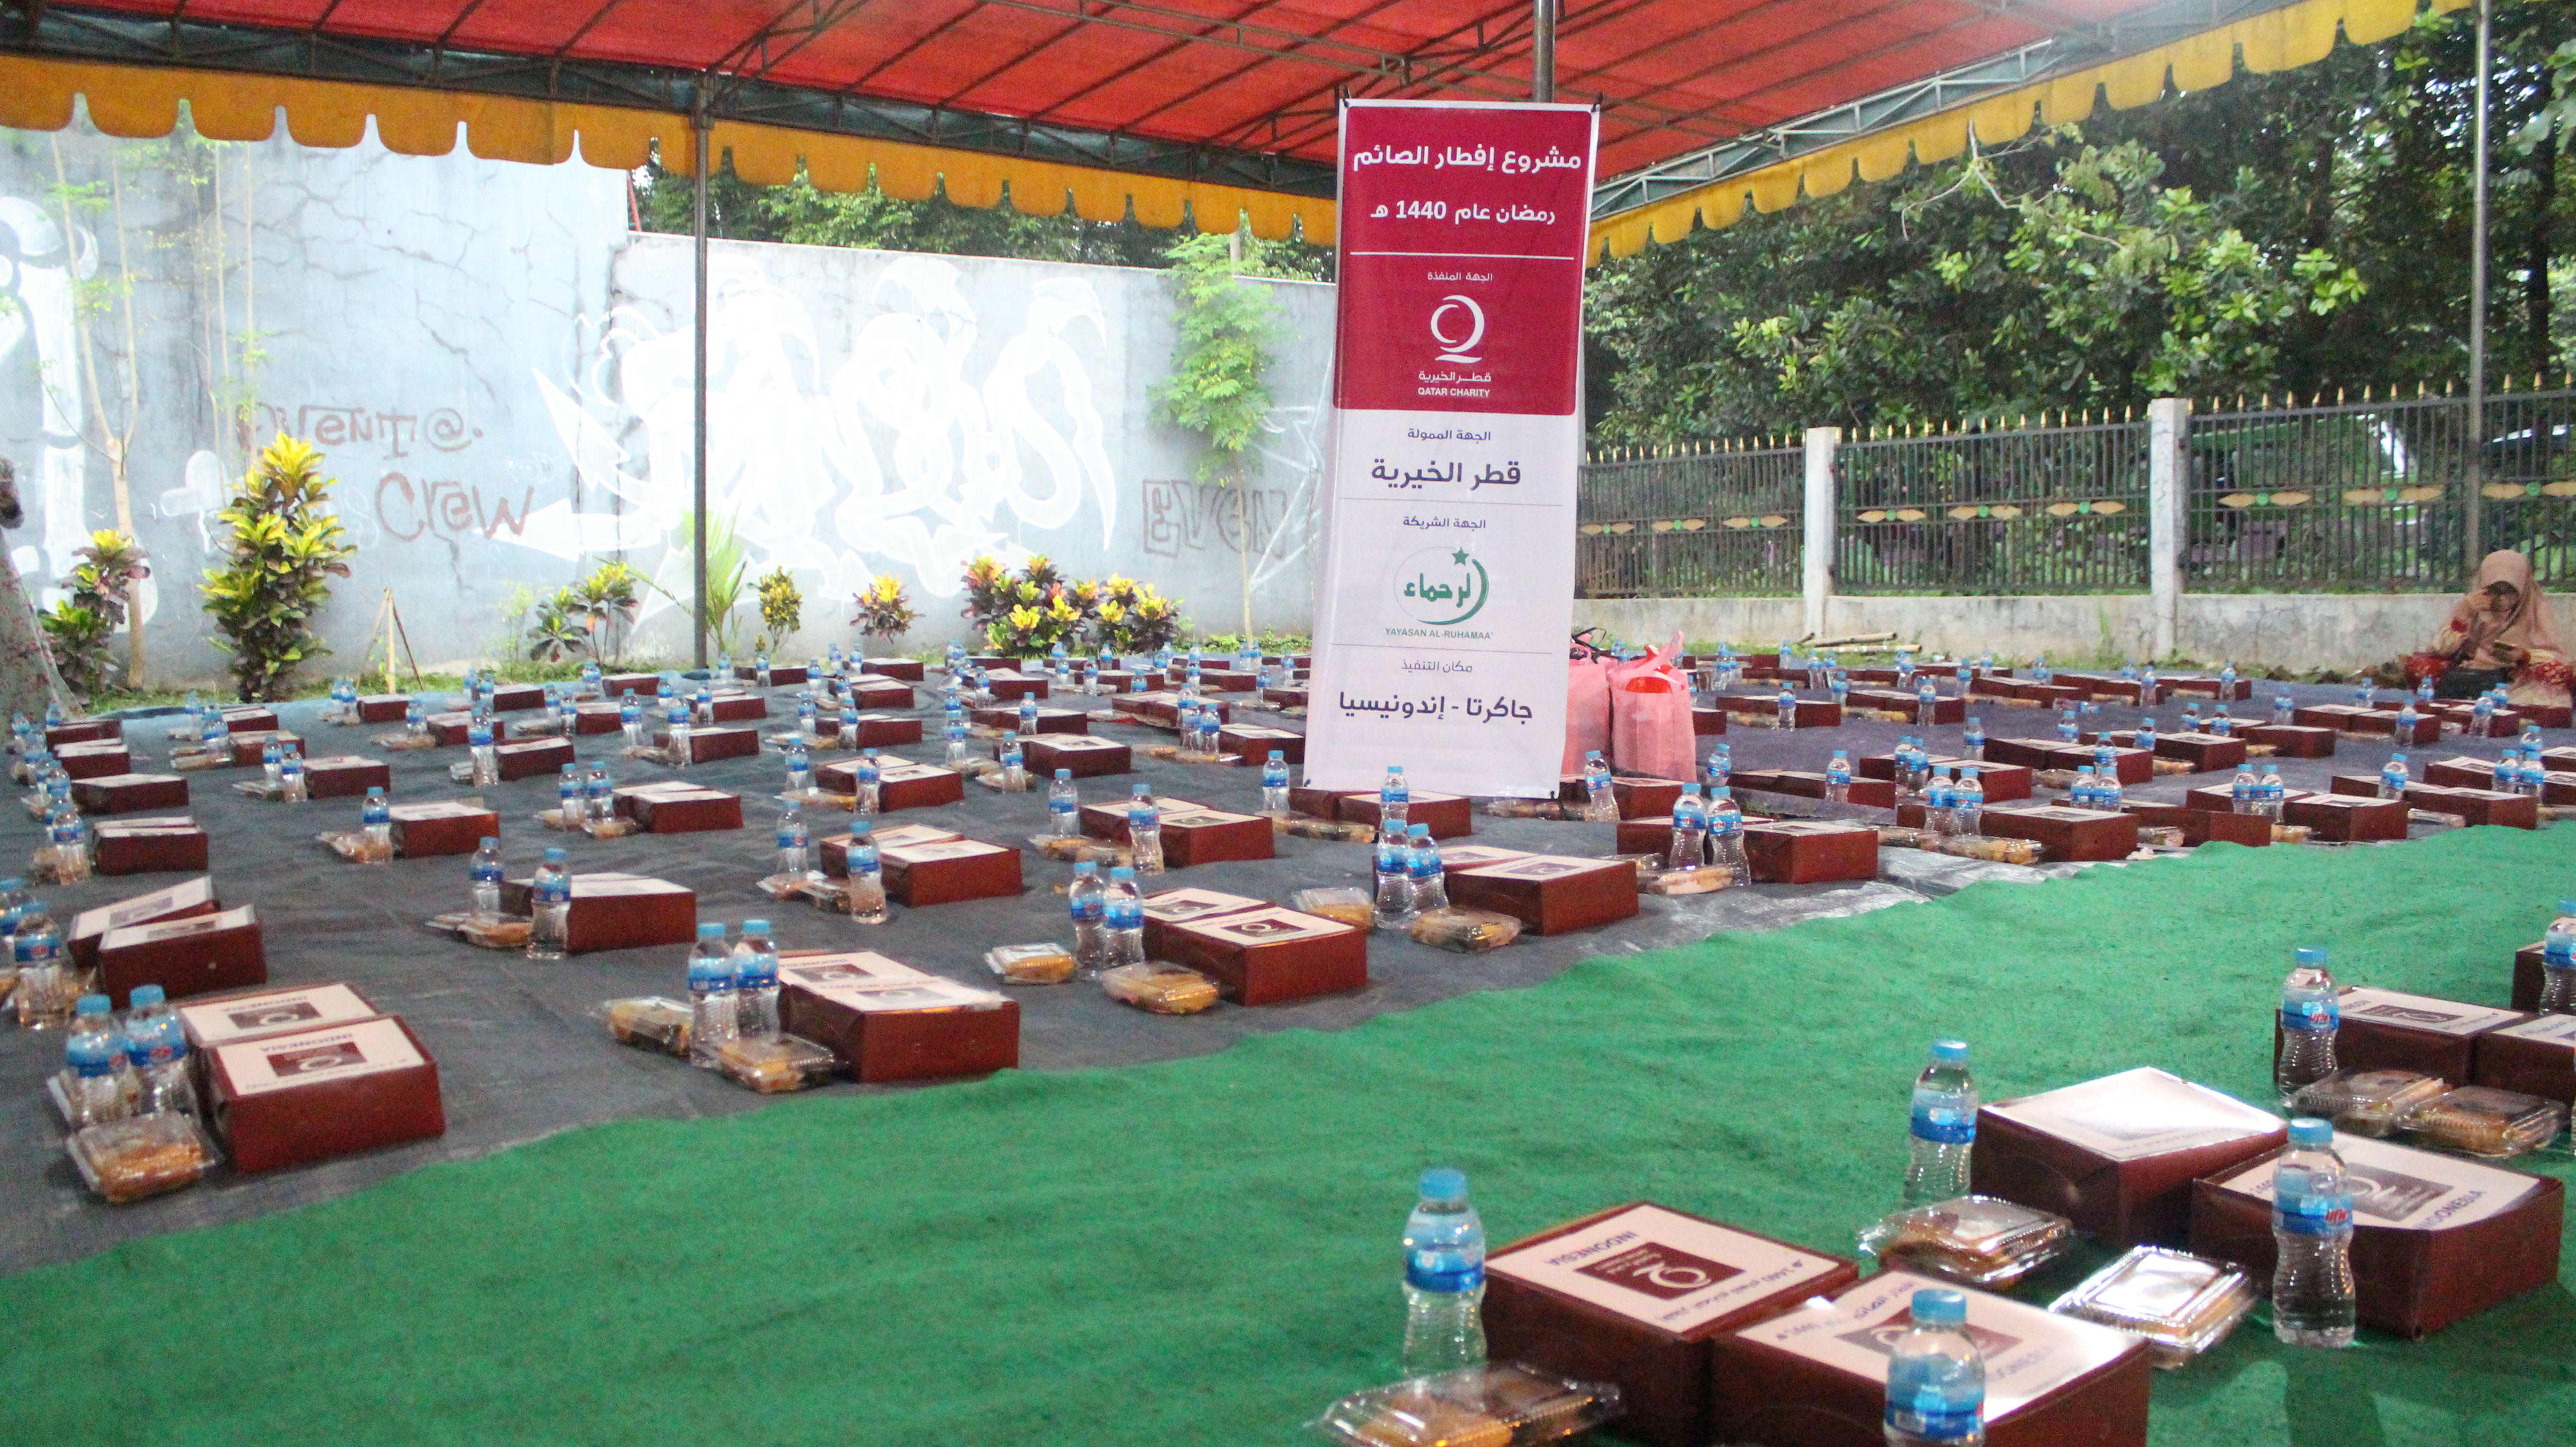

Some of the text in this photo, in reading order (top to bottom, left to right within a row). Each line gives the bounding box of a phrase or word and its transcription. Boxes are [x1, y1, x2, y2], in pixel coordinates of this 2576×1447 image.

[1353, 144, 1582, 174] مشروع إفطار الصائم
[1396, 200, 1447, 220] 1440
[1455, 203, 1490, 225] عام
[1496, 204, 1556, 225] رمضان
[1427, 271, 1493, 283] الجهة المنفذة
[1418, 370, 1491, 384] قطر الخيرية
[1418, 387, 1490, 398] QATAR CHARITY
[1407, 428, 1491, 444] الجهة الممولة
[1371, 458, 1521, 490] قطر الخيرية
[1403, 515, 1487, 532] الجهة الشريكة
[1385, 628, 1427, 637] YAYASAN
[1401, 659, 1473, 673] مكان التنفيذ
[1339, 691, 1445, 720] إندونيسيا
[1466, 696, 1533, 724] جاكرتا
